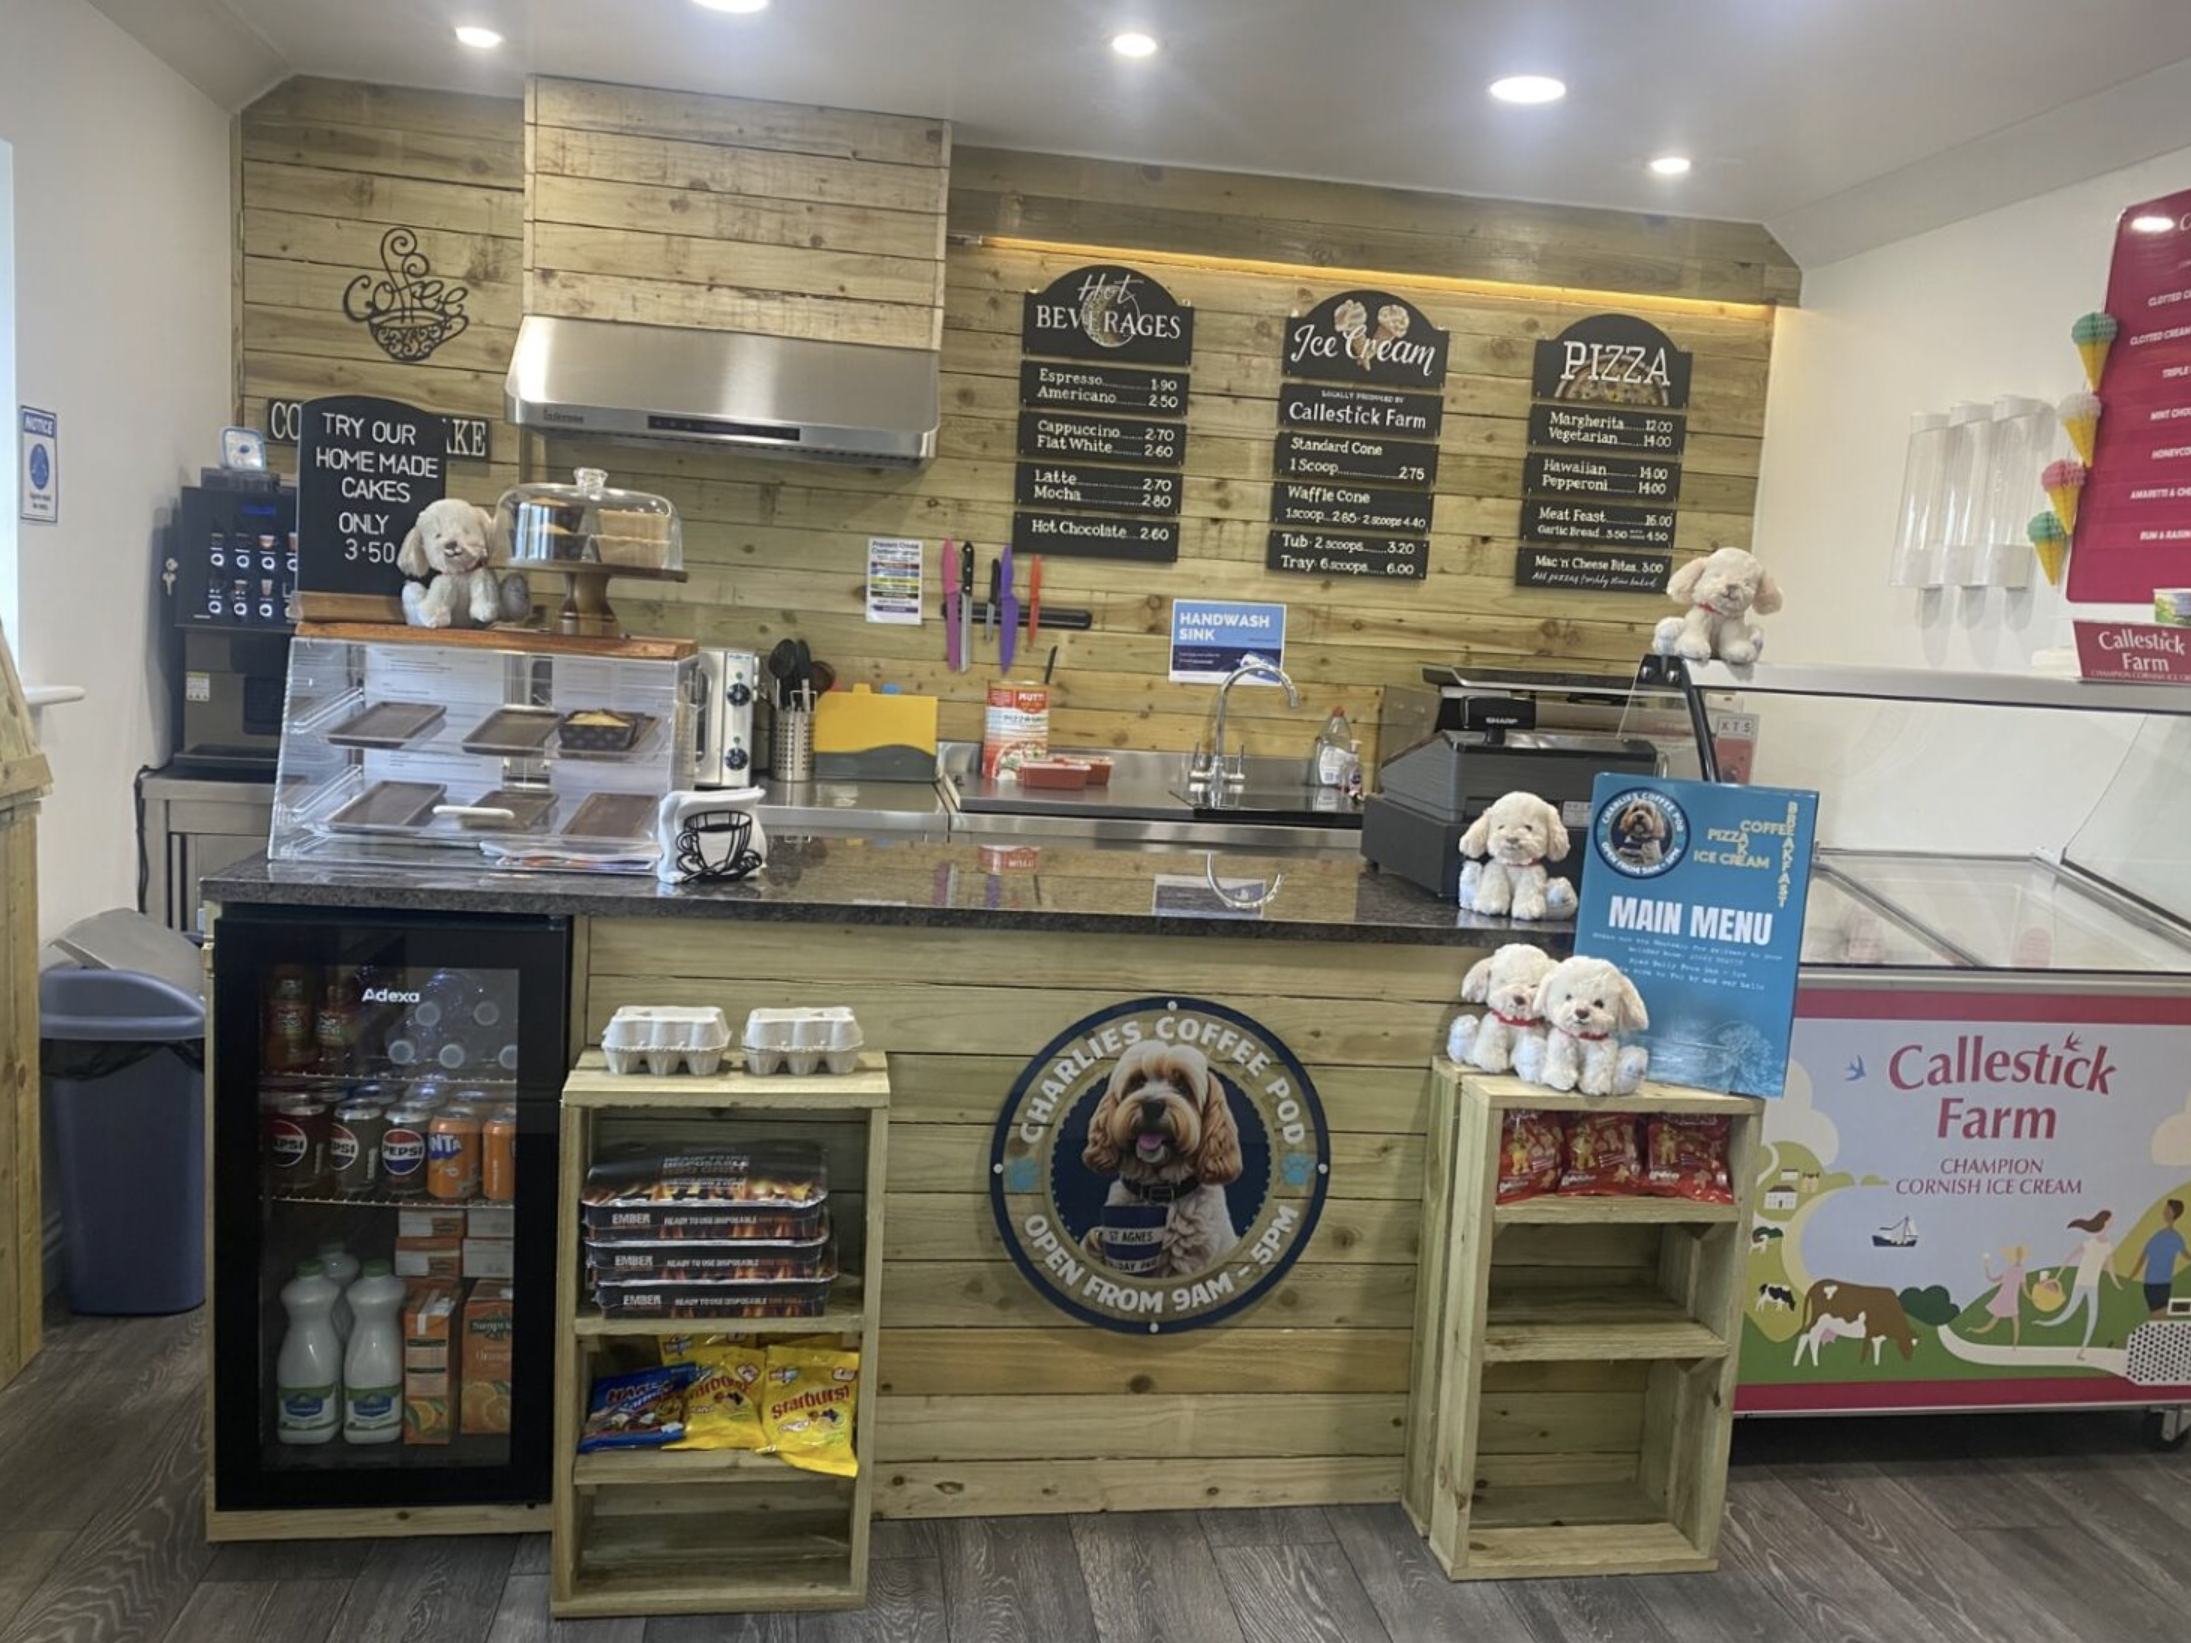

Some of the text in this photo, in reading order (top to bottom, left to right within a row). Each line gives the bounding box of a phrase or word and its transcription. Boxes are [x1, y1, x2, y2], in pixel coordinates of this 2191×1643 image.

[1077, 273, 1144, 304] Hot
[1036, 304, 1181, 339] BEVERAGES
[1290, 324, 1436, 376] Ice Cream
[1560, 341, 1671, 387] PIZZA
[1039, 368, 1103, 387] Espresso
[1037, 386, 1117, 404] Americano
[1288, 402, 1427, 430] Callestick Farm
[1550, 411, 1625, 431] Margherita
[322, 412, 417, 446] TRY OUR
[1038, 419, 1120, 438] Cappuccino
[1548, 427, 1618, 444] Vegetarian
[1037, 436, 1067, 450] Flat
[1069, 436, 1113, 453] White
[1290, 436, 1383, 456] Standard Cone
[315, 447, 439, 479] HOME MADE
[1297, 458, 1339, 476] Scoop
[1543, 459, 1608, 477] Hawaiian
[1034, 470, 1077, 485] Latte
[1541, 475, 1609, 492] Pepperoni
[341, 476, 412, 504] CAKES
[1034, 486, 1082, 501] Mocha
[1287, 484, 1371, 504] Waffle Cone
[338, 511, 390, 535] ONLY
[1539, 506, 1571, 521] Meat
[1573, 508, 1606, 523] Feast
[1032, 519, 1057, 534] Hot
[1059, 521, 1127, 538] Chocolate
[1537, 524, 1568, 536] Garlic
[1569, 526, 1600, 538] Bread
[1281, 533, 1309, 548] Tub
[1314, 536, 1323, 549] 2
[1324, 540, 1366, 554] scoops
[1281, 554, 1316, 573] Tray
[1329, 562, 1368, 575] scoops
[1535, 555, 1558, 568] Mac
[1571, 557, 1609, 571] Cheese
[1179, 612, 1271, 628] HANDWASH
[1178, 628, 1216, 642] SINK
[2098, 628, 2186, 656] Callestick
[2122, 652, 2169, 672] Farm
[1485, 716, 1519, 725] SHARP
[1708, 827, 1748, 844] PIZZA
[1740, 819, 1795, 837] COFFEE
[1693, 849, 1770, 870] ICE CREAM
[1608, 895, 1683, 936] MAIN
[1689, 904, 1774, 946] MENU
[361, 988, 421, 1004] Adexa
[1888, 1034, 2118, 1096] Callestick
[1019, 1016, 1306, 1145] CHARLIES COFFEE POD
[1937, 1097, 2058, 1140] Farm
[1940, 1157, 2044, 1175] CHAMPION
[1895, 1178, 2083, 1196] CORNISH ICE CREAM
[612, 1213, 650, 1224] EMBER
[615, 1255, 653, 1267] EMBER
[1024, 1214, 1085, 1287] OPEN
[1082, 1276, 1164, 1314] FROM
[1172, 1272, 1235, 1312] 9AM
[1250, 1204, 1300, 1266] 5PM
[623, 1294, 661, 1305] EMBER
